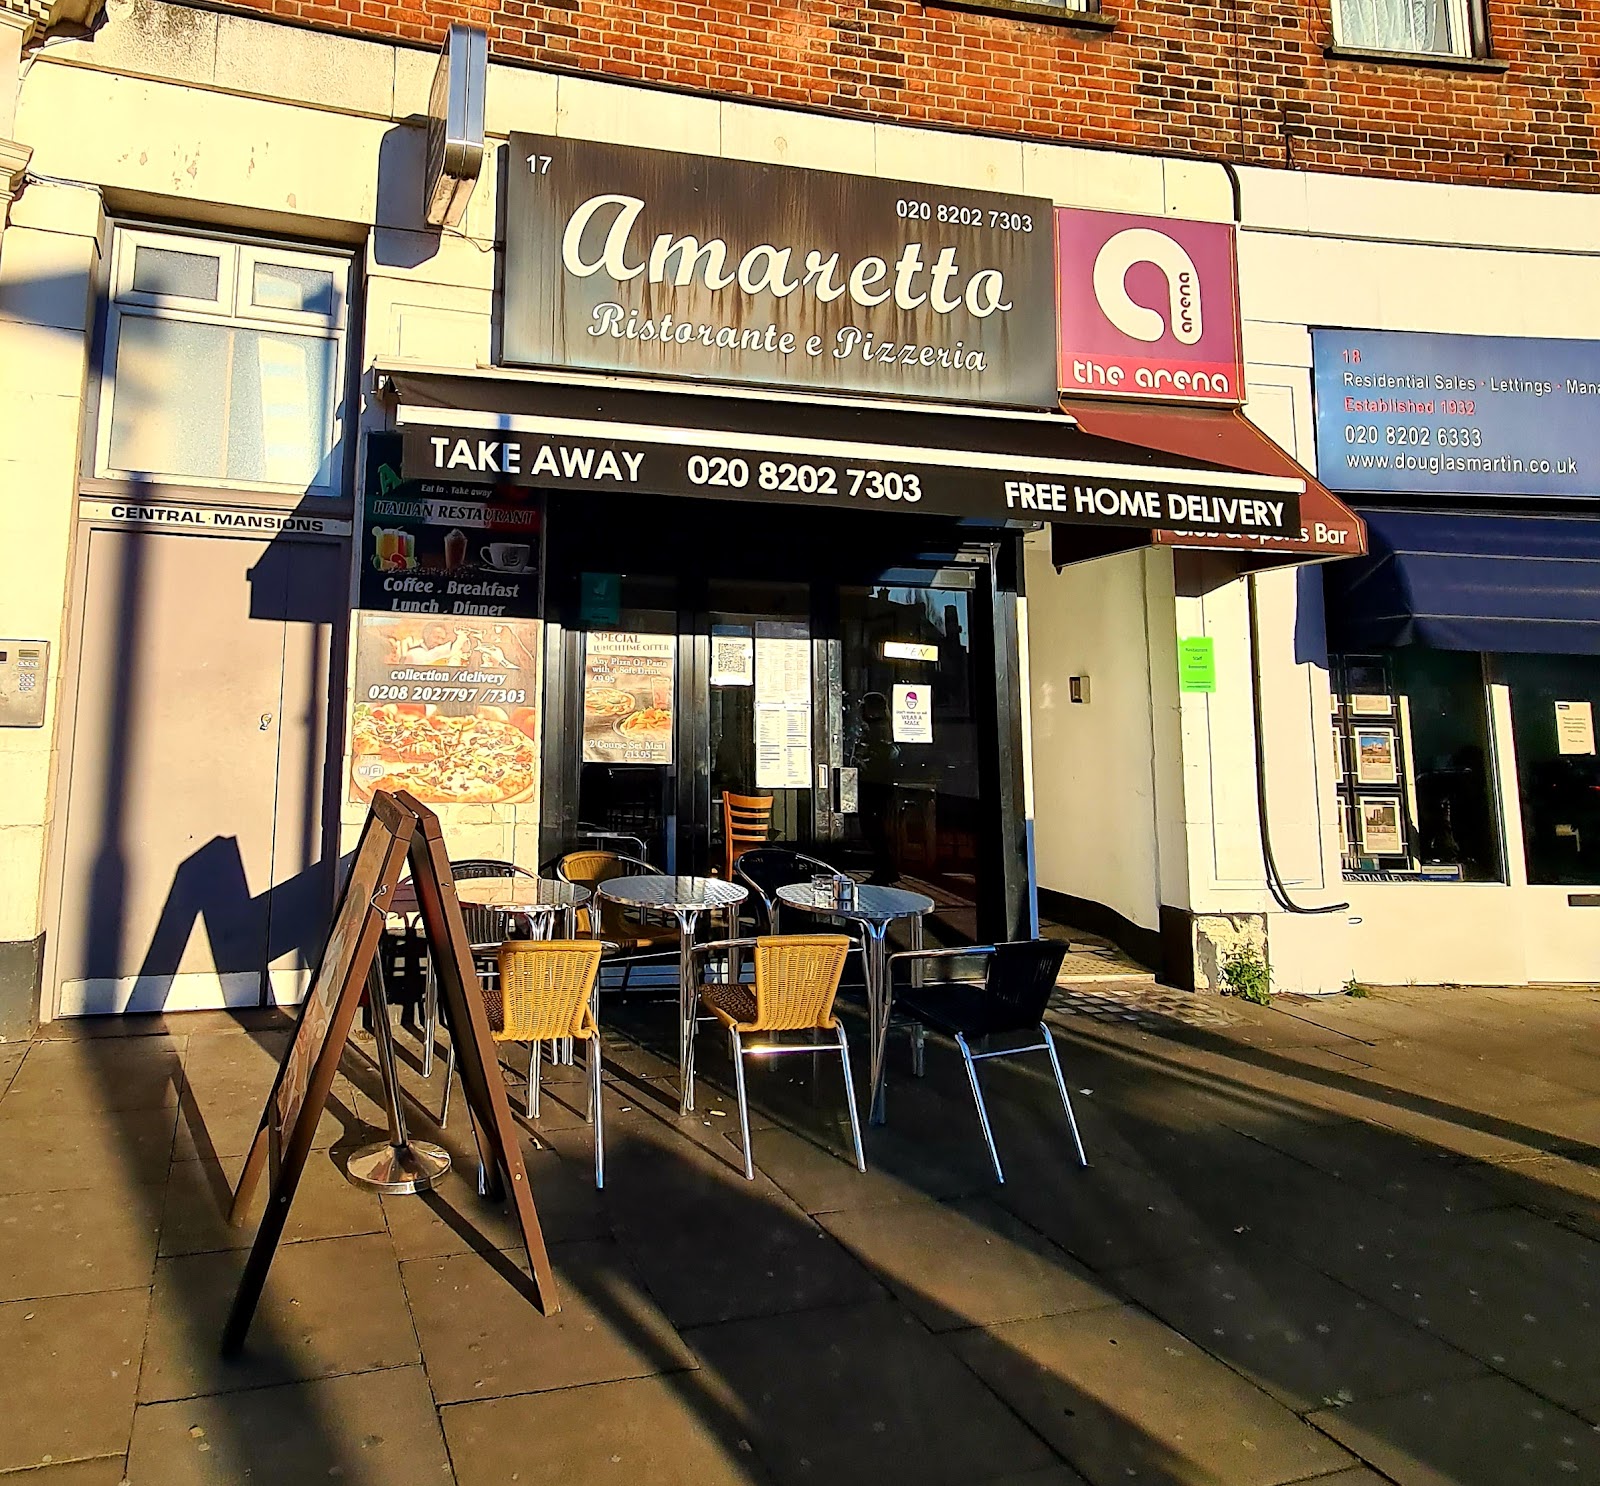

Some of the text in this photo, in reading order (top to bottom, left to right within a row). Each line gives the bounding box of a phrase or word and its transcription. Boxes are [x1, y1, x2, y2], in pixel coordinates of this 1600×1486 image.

[526, 154, 553, 175] 17
[896, 200, 1034, 233] 020 8202 7303
[561, 193, 1013, 318] Amaretto
[1179, 272, 1192, 333] arena
[587, 302, 988, 371] Ristorante e Pizzeria
[1342, 349, 1362, 364] 18
[1073, 359, 1229, 393] the arena
[1343, 372, 1430, 389] Residential
[1434, 374, 1476, 391] Sales
[1490, 377, 1552, 396] Lettings
[1344, 397, 1476, 415] Established 1932
[1345, 425, 1482, 447] 020 8202 6333
[1346, 452, 1578, 475] www.douglasmartin.co.uk
[430, 436, 1284, 528] TAKE AWAY 020 8202 7303 FREE HOME DELIVERY
[471, 488, 493, 499] away
[111, 506, 324, 532] CENTRAL MANSIONS
[373, 500, 535, 526] ITALIAN RESTAURANT
[1314, 522, 1349, 545] Bar
[384, 577, 520, 598] Coffee Breakfast
[392, 599, 505, 616] Lunch Dinner
[593, 633, 641, 644] SPECIAL
[391, 669, 450, 683] collection
[369, 685, 408, 700] 0208
[411, 687, 478, 702] 2027797
